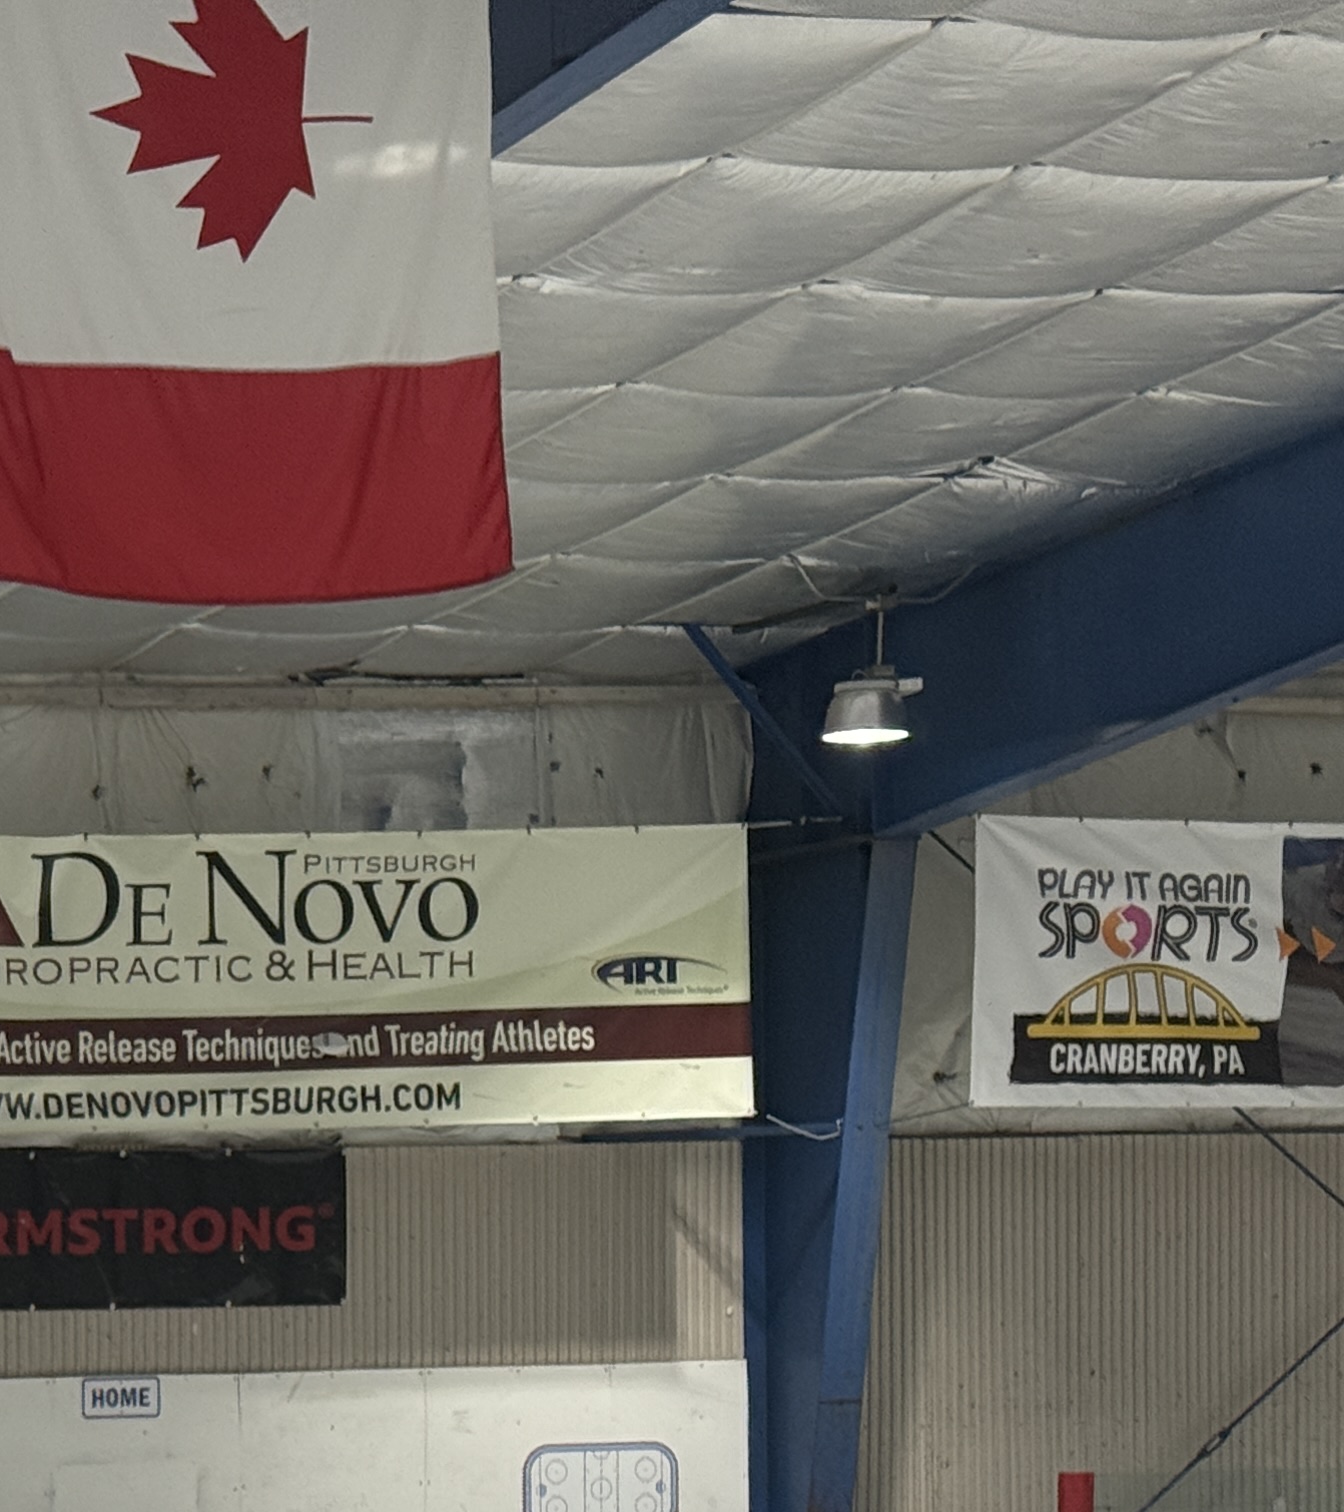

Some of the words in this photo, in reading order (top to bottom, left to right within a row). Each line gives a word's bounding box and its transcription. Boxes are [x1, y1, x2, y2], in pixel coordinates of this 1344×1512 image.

[303, 854, 476, 874] PITTSBURGH
[196, 849, 479, 947] NOVO
[1039, 868, 1114, 898] PLAY
[1125, 872, 1151, 900] IT
[1160, 873, 1250, 904] AGAIN
[1039, 902, 1258, 962] SPORTS
[265, 951, 295, 982] &
[307, 949, 475, 981] HEALTH
[79, 1031, 176, 1063] Release
[335, 1024, 380, 1058] nd
[385, 1024, 485, 1062] Treating
[492, 1022, 595, 1053] Athletes
[1050, 1043, 1205, 1078] CRANBERRY,
[1214, 1046, 1245, 1075] PA
[91, 1387, 150, 1408] HOME
